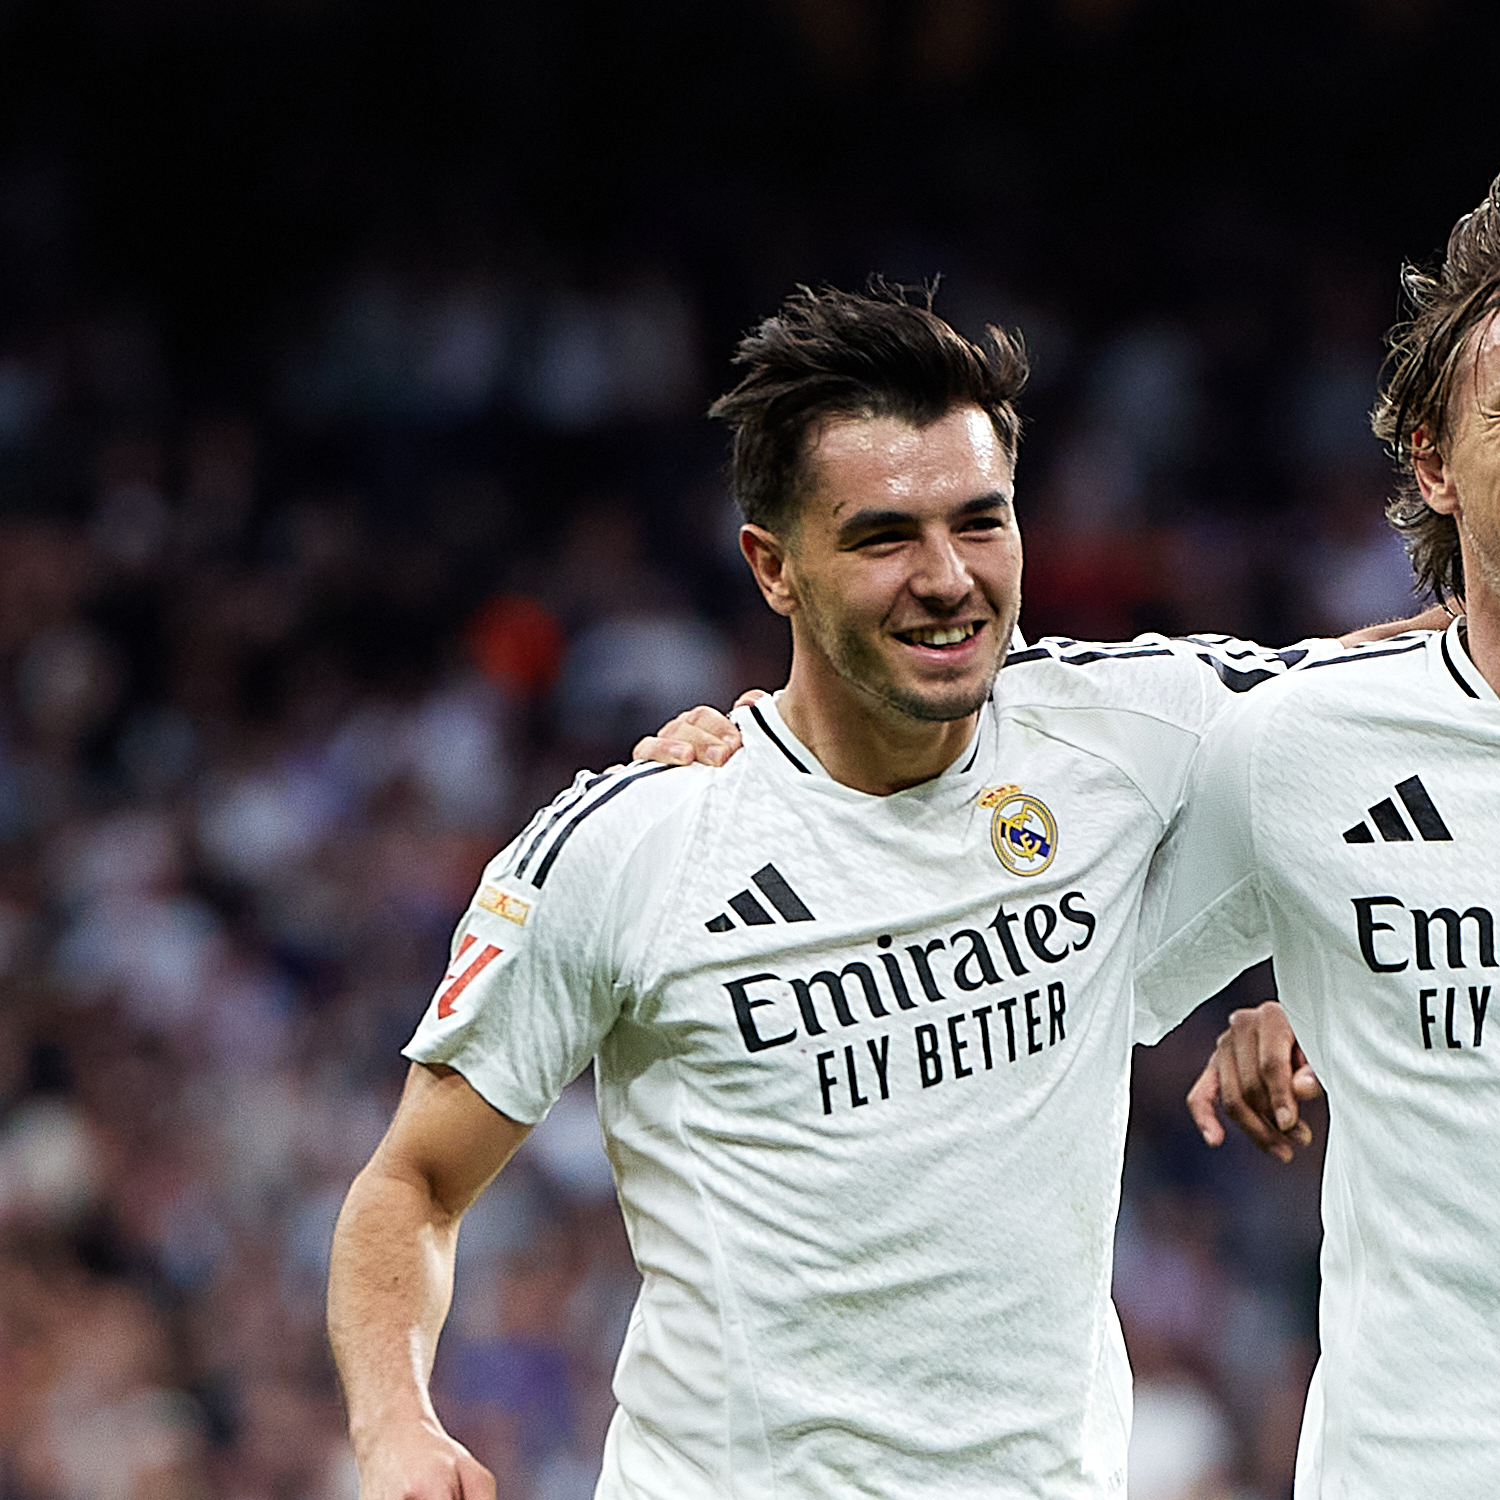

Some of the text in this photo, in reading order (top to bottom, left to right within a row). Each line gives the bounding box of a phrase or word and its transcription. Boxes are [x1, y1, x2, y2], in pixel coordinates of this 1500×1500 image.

[722, 891, 1097, 1053] Emirates
[1419, 985, 1492, 1050] FLY
[816, 980, 1068, 1116] FLY BETTER
